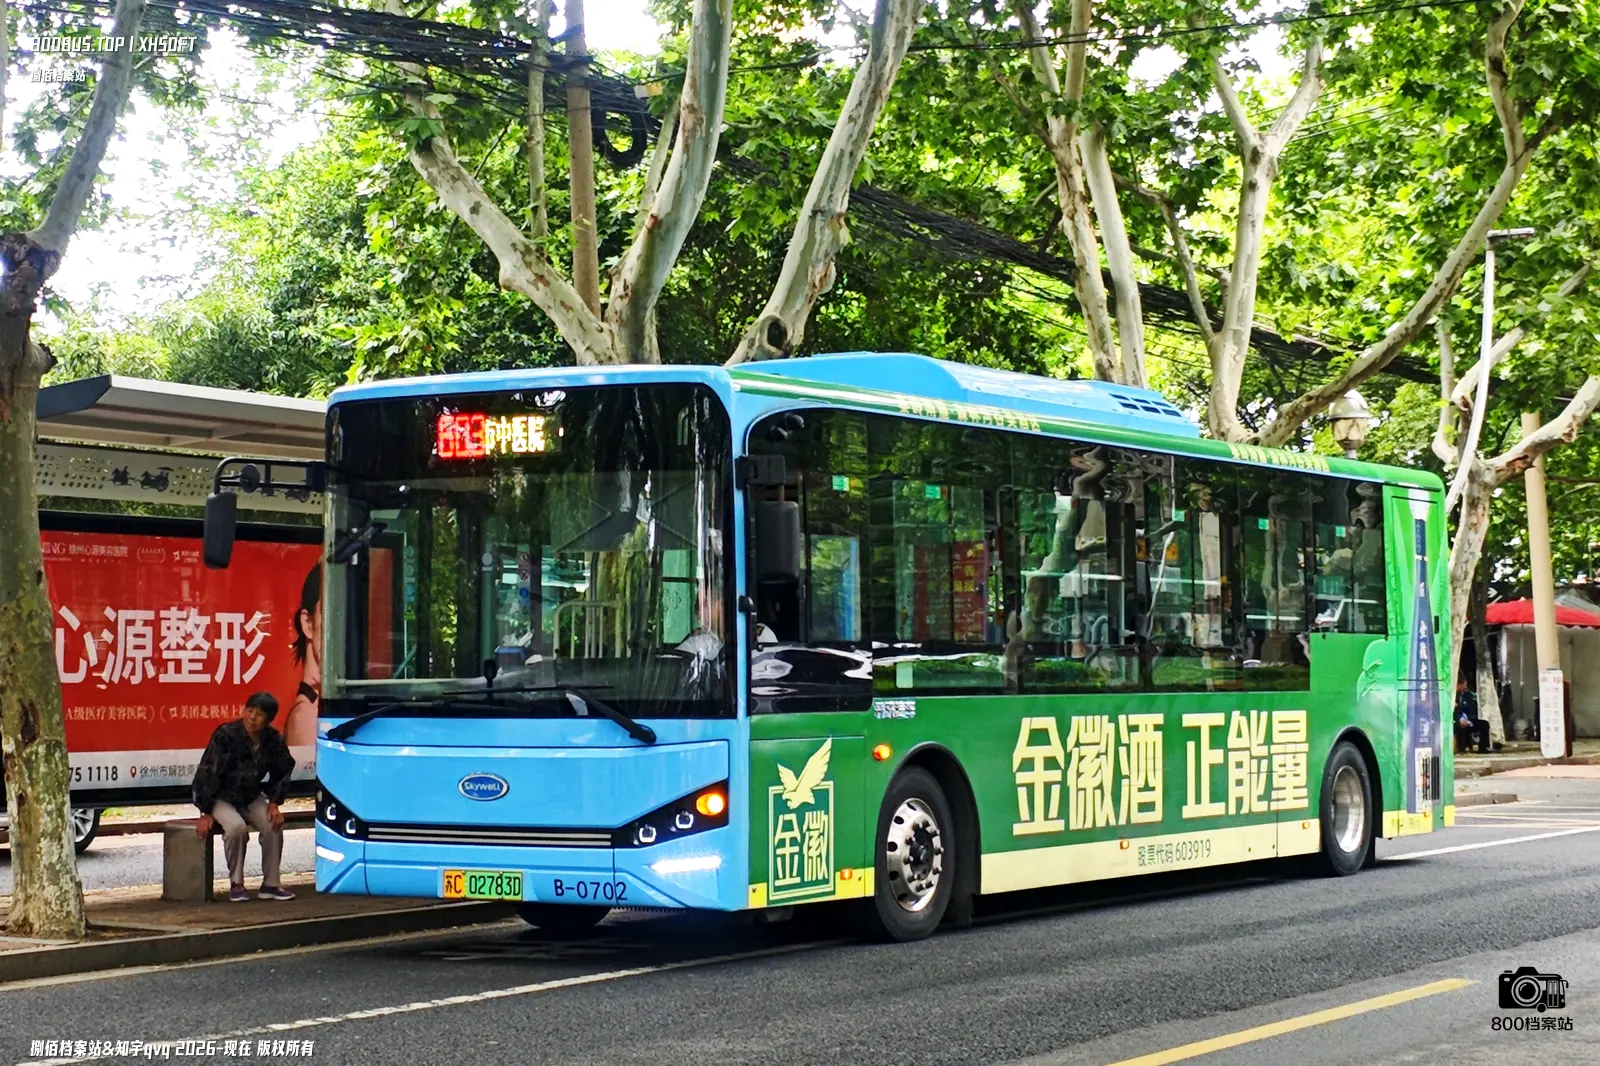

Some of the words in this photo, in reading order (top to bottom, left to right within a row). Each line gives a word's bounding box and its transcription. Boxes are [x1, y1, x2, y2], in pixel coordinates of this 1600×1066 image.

[55, 605, 272, 685] 心源整形
[88, 765, 118, 781] 1118
[140, 764, 200, 777] 徐州市解放南
[1012, 714, 1164, 836] 金徽酒
[1182, 709, 1310, 820] 正能量
[774, 810, 829, 887] 金徽
[1138, 843, 1174, 867] 股票代码
[1175, 838, 1212, 862] 603919
[469, 875, 521, 896] 02783D
[554, 879, 627, 901] B-0702
